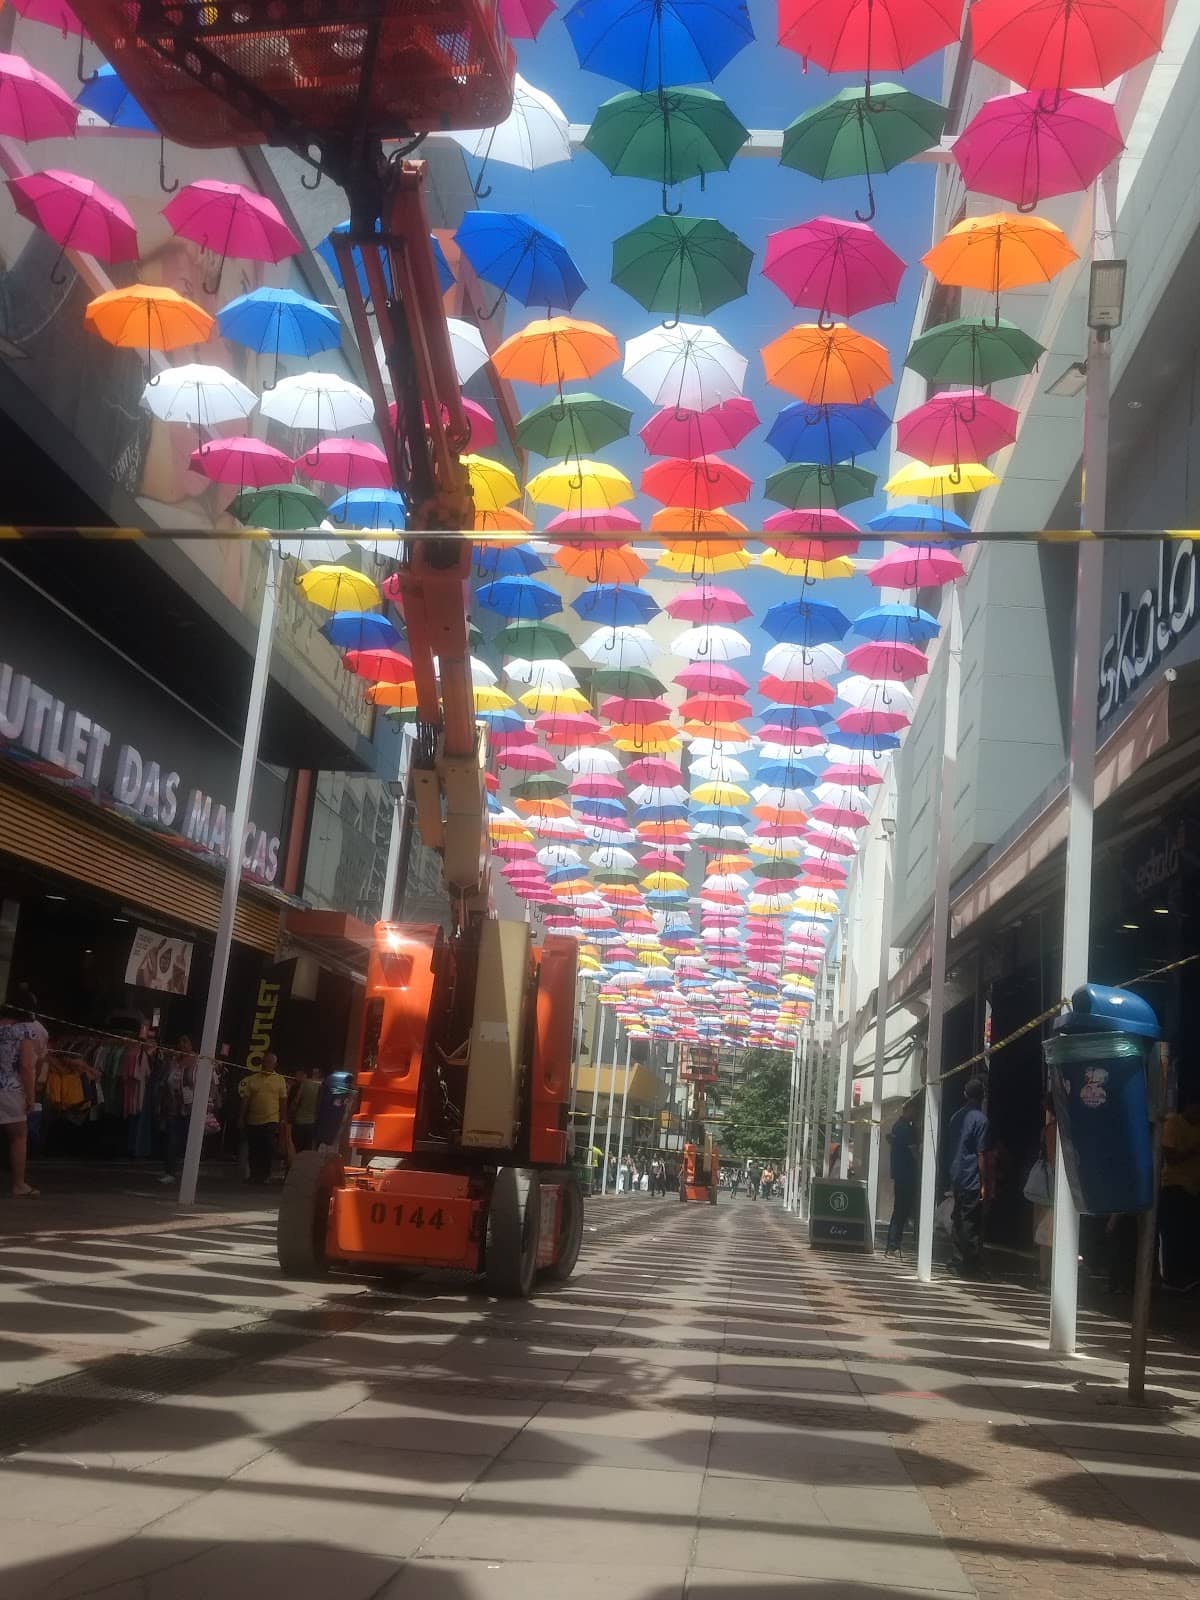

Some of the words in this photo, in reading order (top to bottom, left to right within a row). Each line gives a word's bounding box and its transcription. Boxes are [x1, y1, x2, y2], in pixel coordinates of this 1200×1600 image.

[1099, 539, 1196, 721] skala
[0, 662, 111, 787] UTLET
[113, 744, 180, 827] DAS
[182, 789, 280, 882] MACAS
[246, 978, 280, 1072] OUTLET
[370, 1202, 444, 1230] 0144
